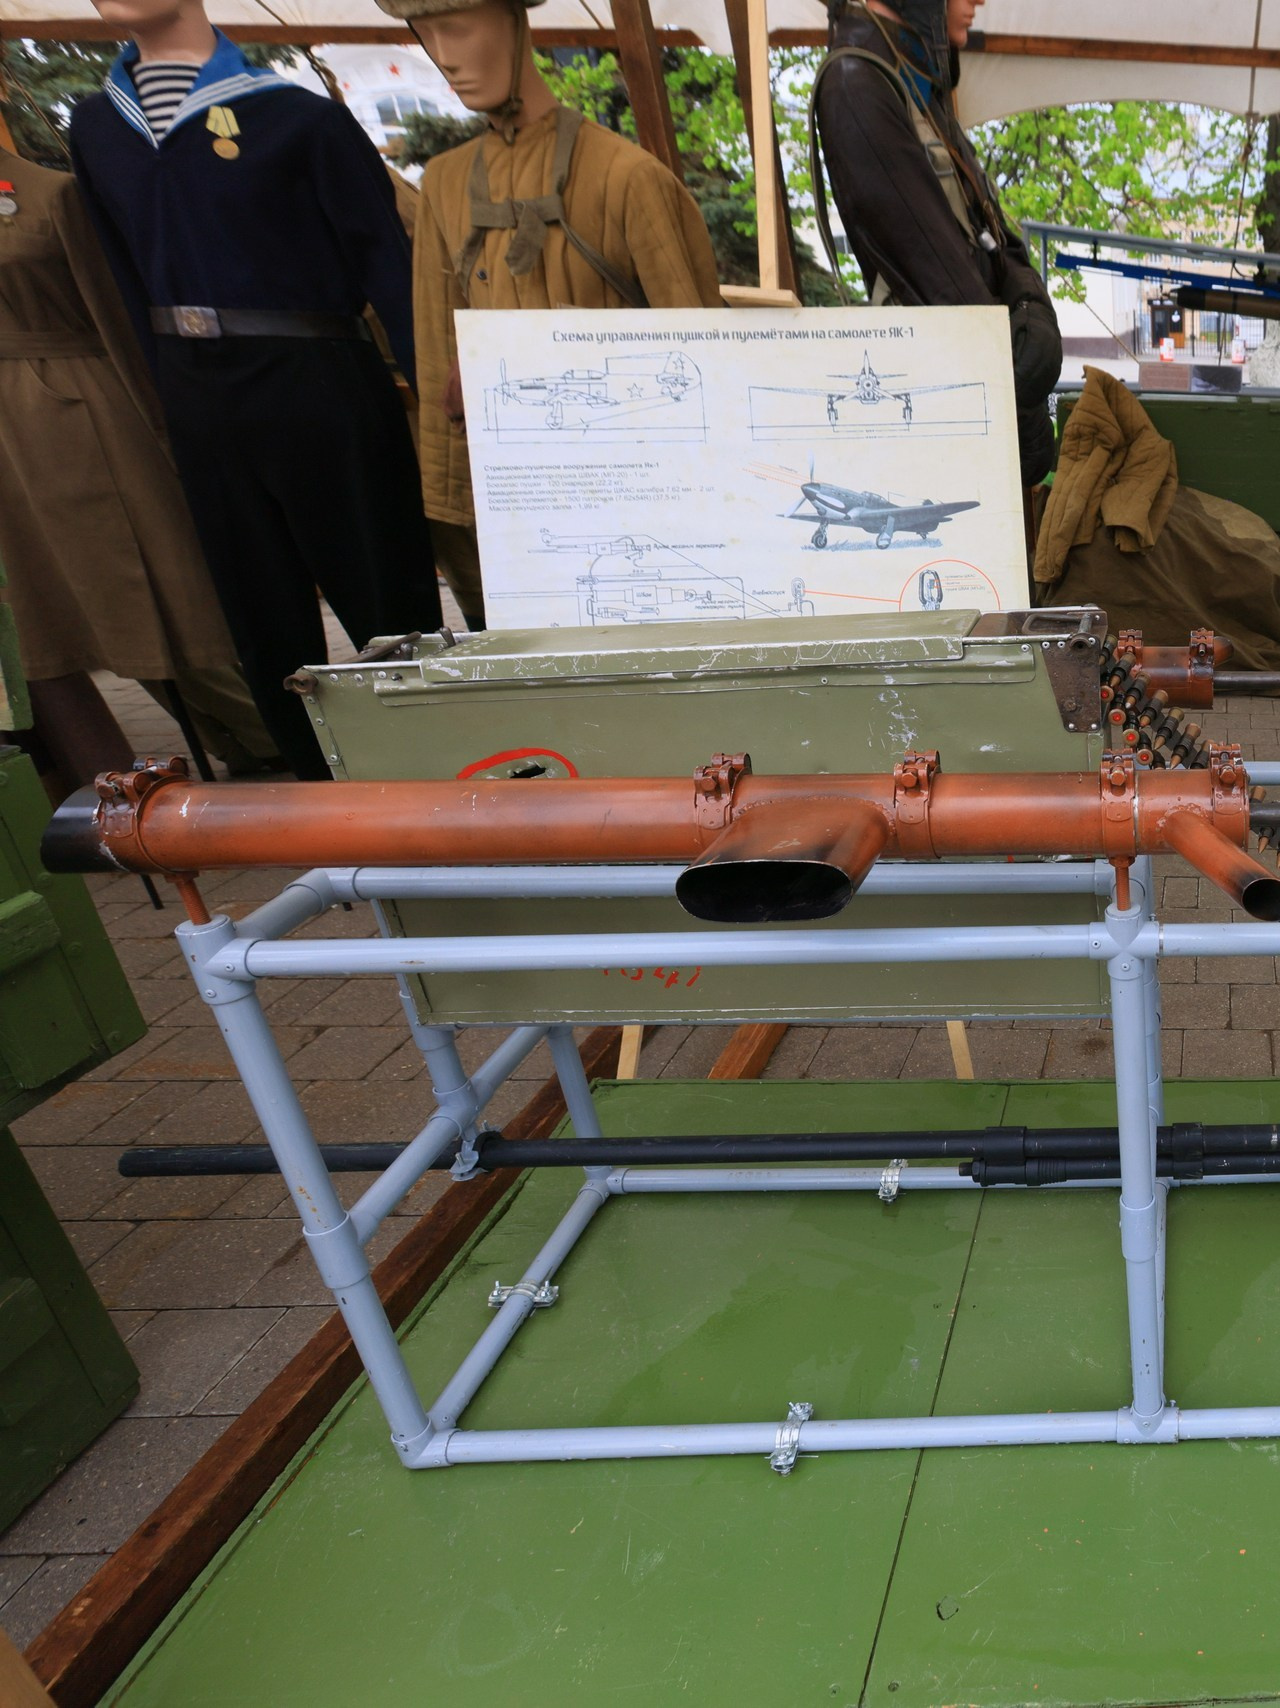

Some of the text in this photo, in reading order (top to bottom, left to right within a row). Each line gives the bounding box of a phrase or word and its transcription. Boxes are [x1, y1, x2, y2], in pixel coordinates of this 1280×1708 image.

[552, 326, 914, 344] Схема управления пушкой и пулемётами на самолете ЯК-1
[563, 463, 607, 471] вооружение
